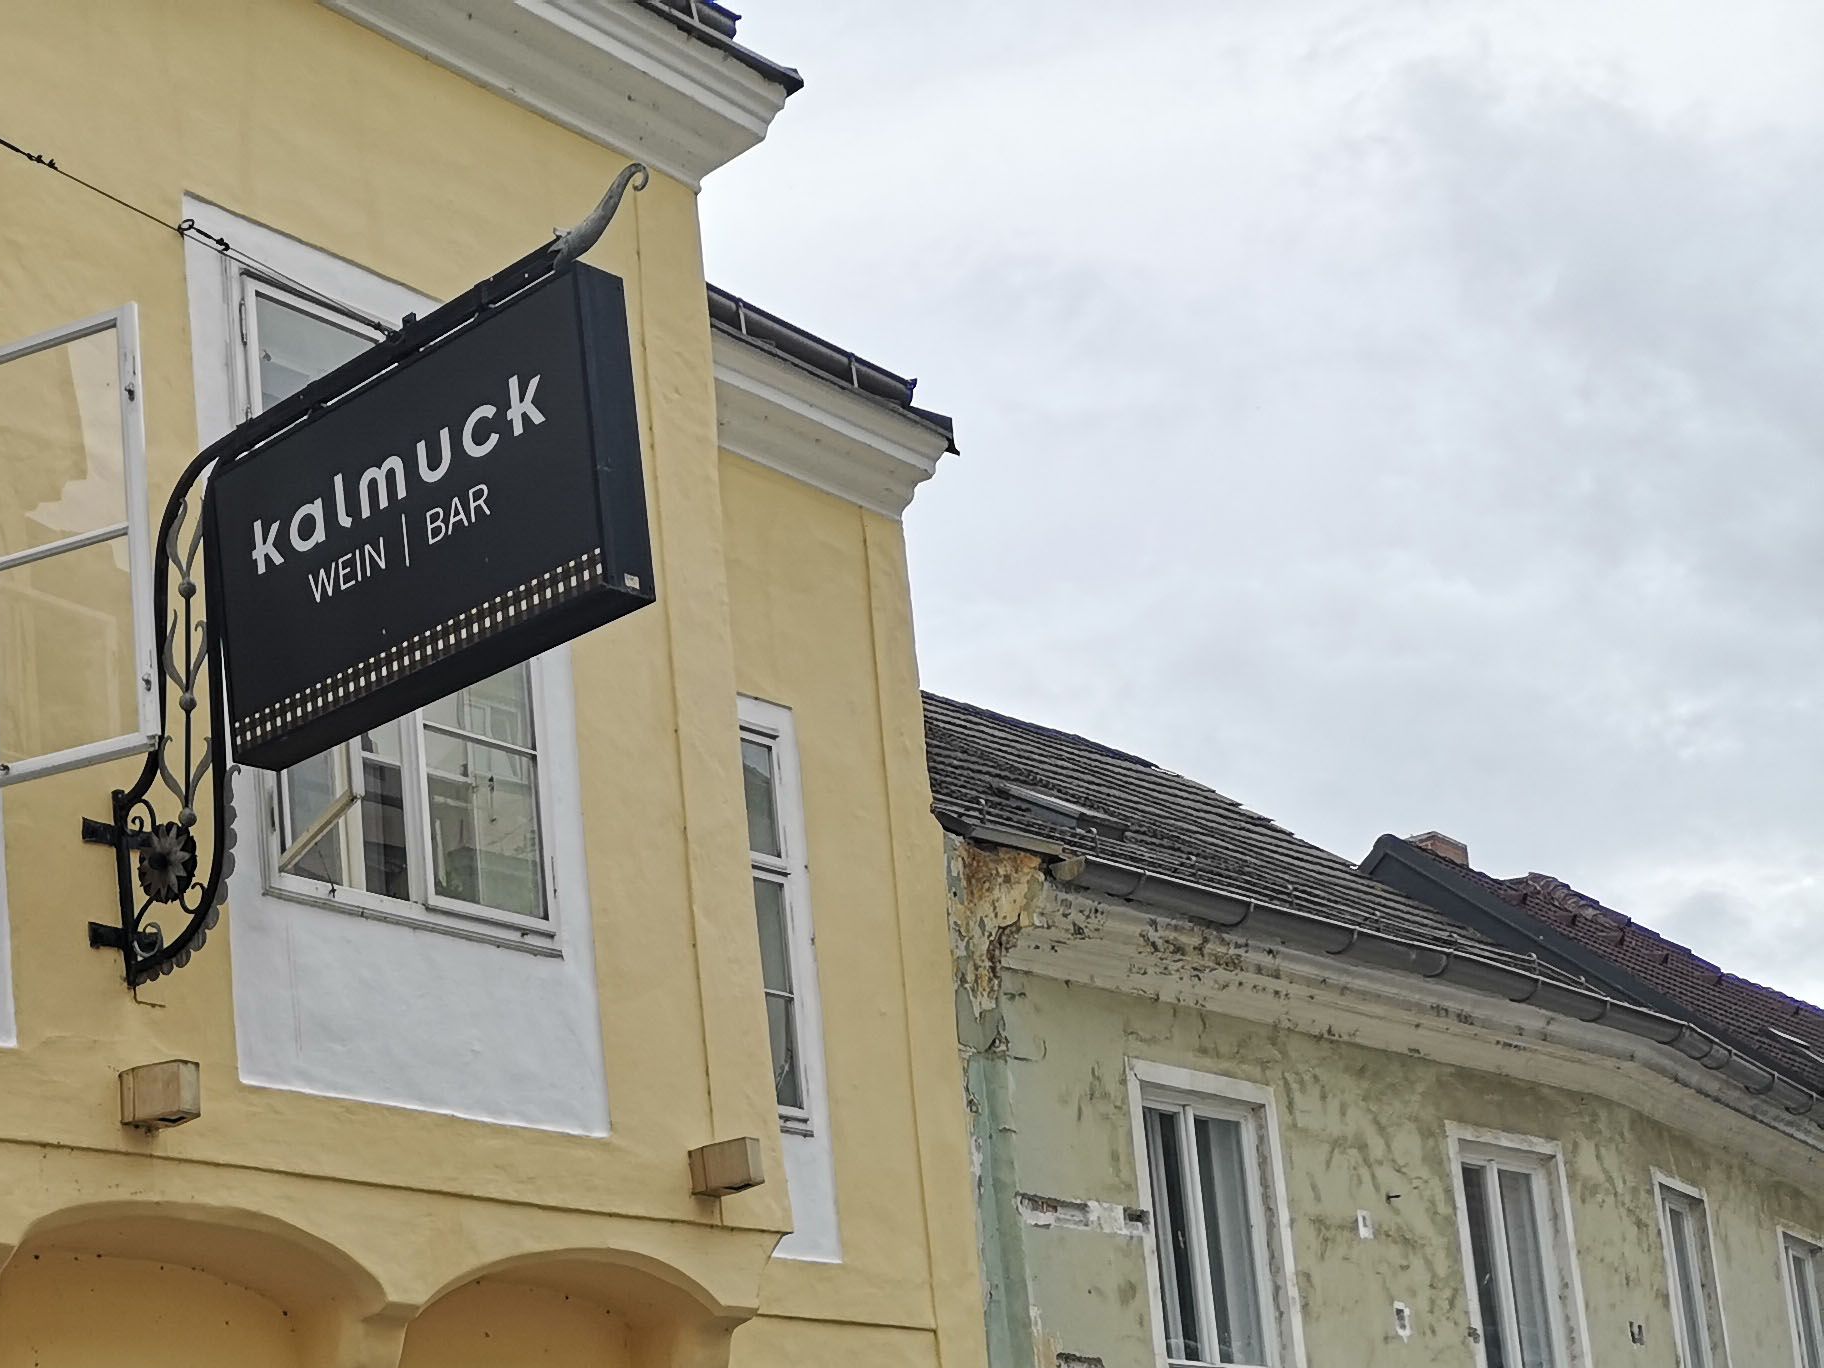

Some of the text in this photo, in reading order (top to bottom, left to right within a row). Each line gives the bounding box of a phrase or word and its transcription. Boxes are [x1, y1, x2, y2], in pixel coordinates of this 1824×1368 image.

[252, 374, 546, 575] kalmuck
[308, 483, 491, 604] WEIN BAR
